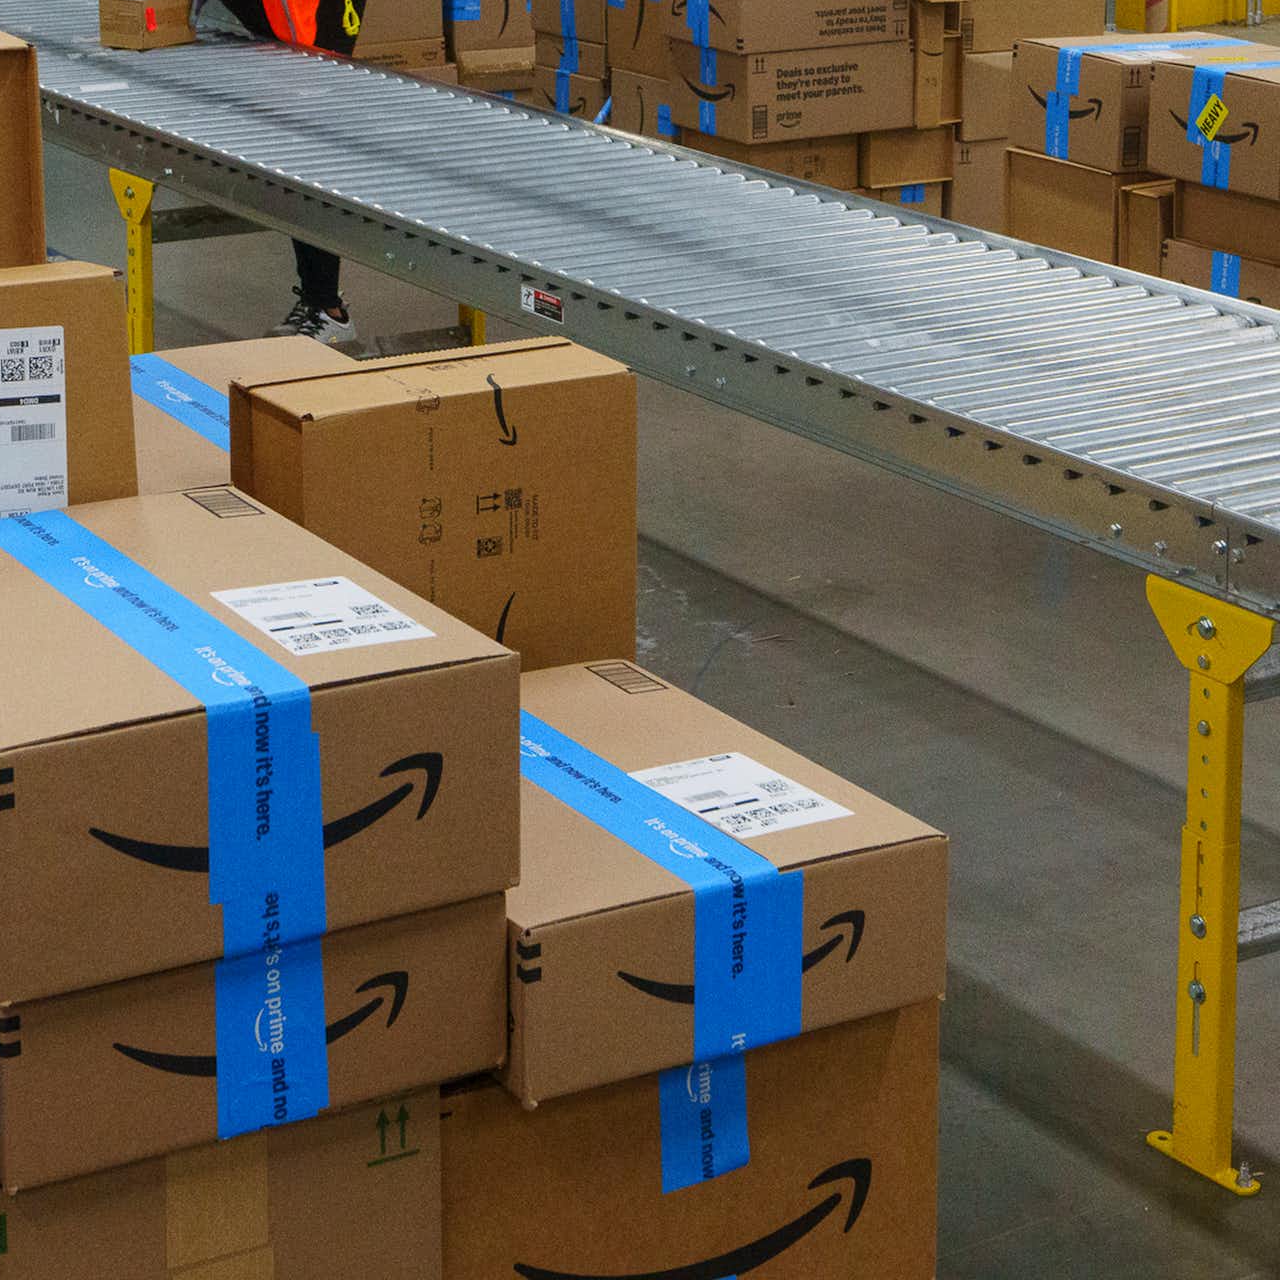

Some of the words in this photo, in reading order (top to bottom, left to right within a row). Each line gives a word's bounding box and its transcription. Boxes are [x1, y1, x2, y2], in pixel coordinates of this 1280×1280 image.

[776, 67, 802, 79] Deals
[804, 68, 815, 76] so
[816, 63, 858, 75] exclusive
[776, 78, 811, 90] they're
[812, 76, 840, 88] ready
[841, 75, 850, 83] to
[776, 90, 801, 102] meet
[802, 89, 824, 101] your
[825, 84, 865, 98] parents.
[776, 111, 802, 121] prime
[1200, 102, 1223, 136] HEAVY
[214, 663, 253, 688] prime
[243, 683, 272, 714] and
[255, 713, 271, 758] now
[255, 758, 278, 789] it's
[546, 753, 566, 771] and
[565, 761, 583, 784] now
[597, 783, 623, 804] here.
[255, 790, 274, 842] here.
[642, 816, 663, 836] It's
[662, 828, 679, 845] on
[675, 835, 709, 860] prime
[707, 854, 731, 874] and
[727, 865, 746, 904] now
[732, 904, 749, 930] it's
[731, 930, 746, 980] here.
[266, 968, 282, 994] on
[265, 996, 287, 1054] prime
[271, 1058, 289, 1094] and
[698, 1063, 714, 1104] rime
[700, 1109, 716, 1139] and
[702, 1141, 716, 1179] now
